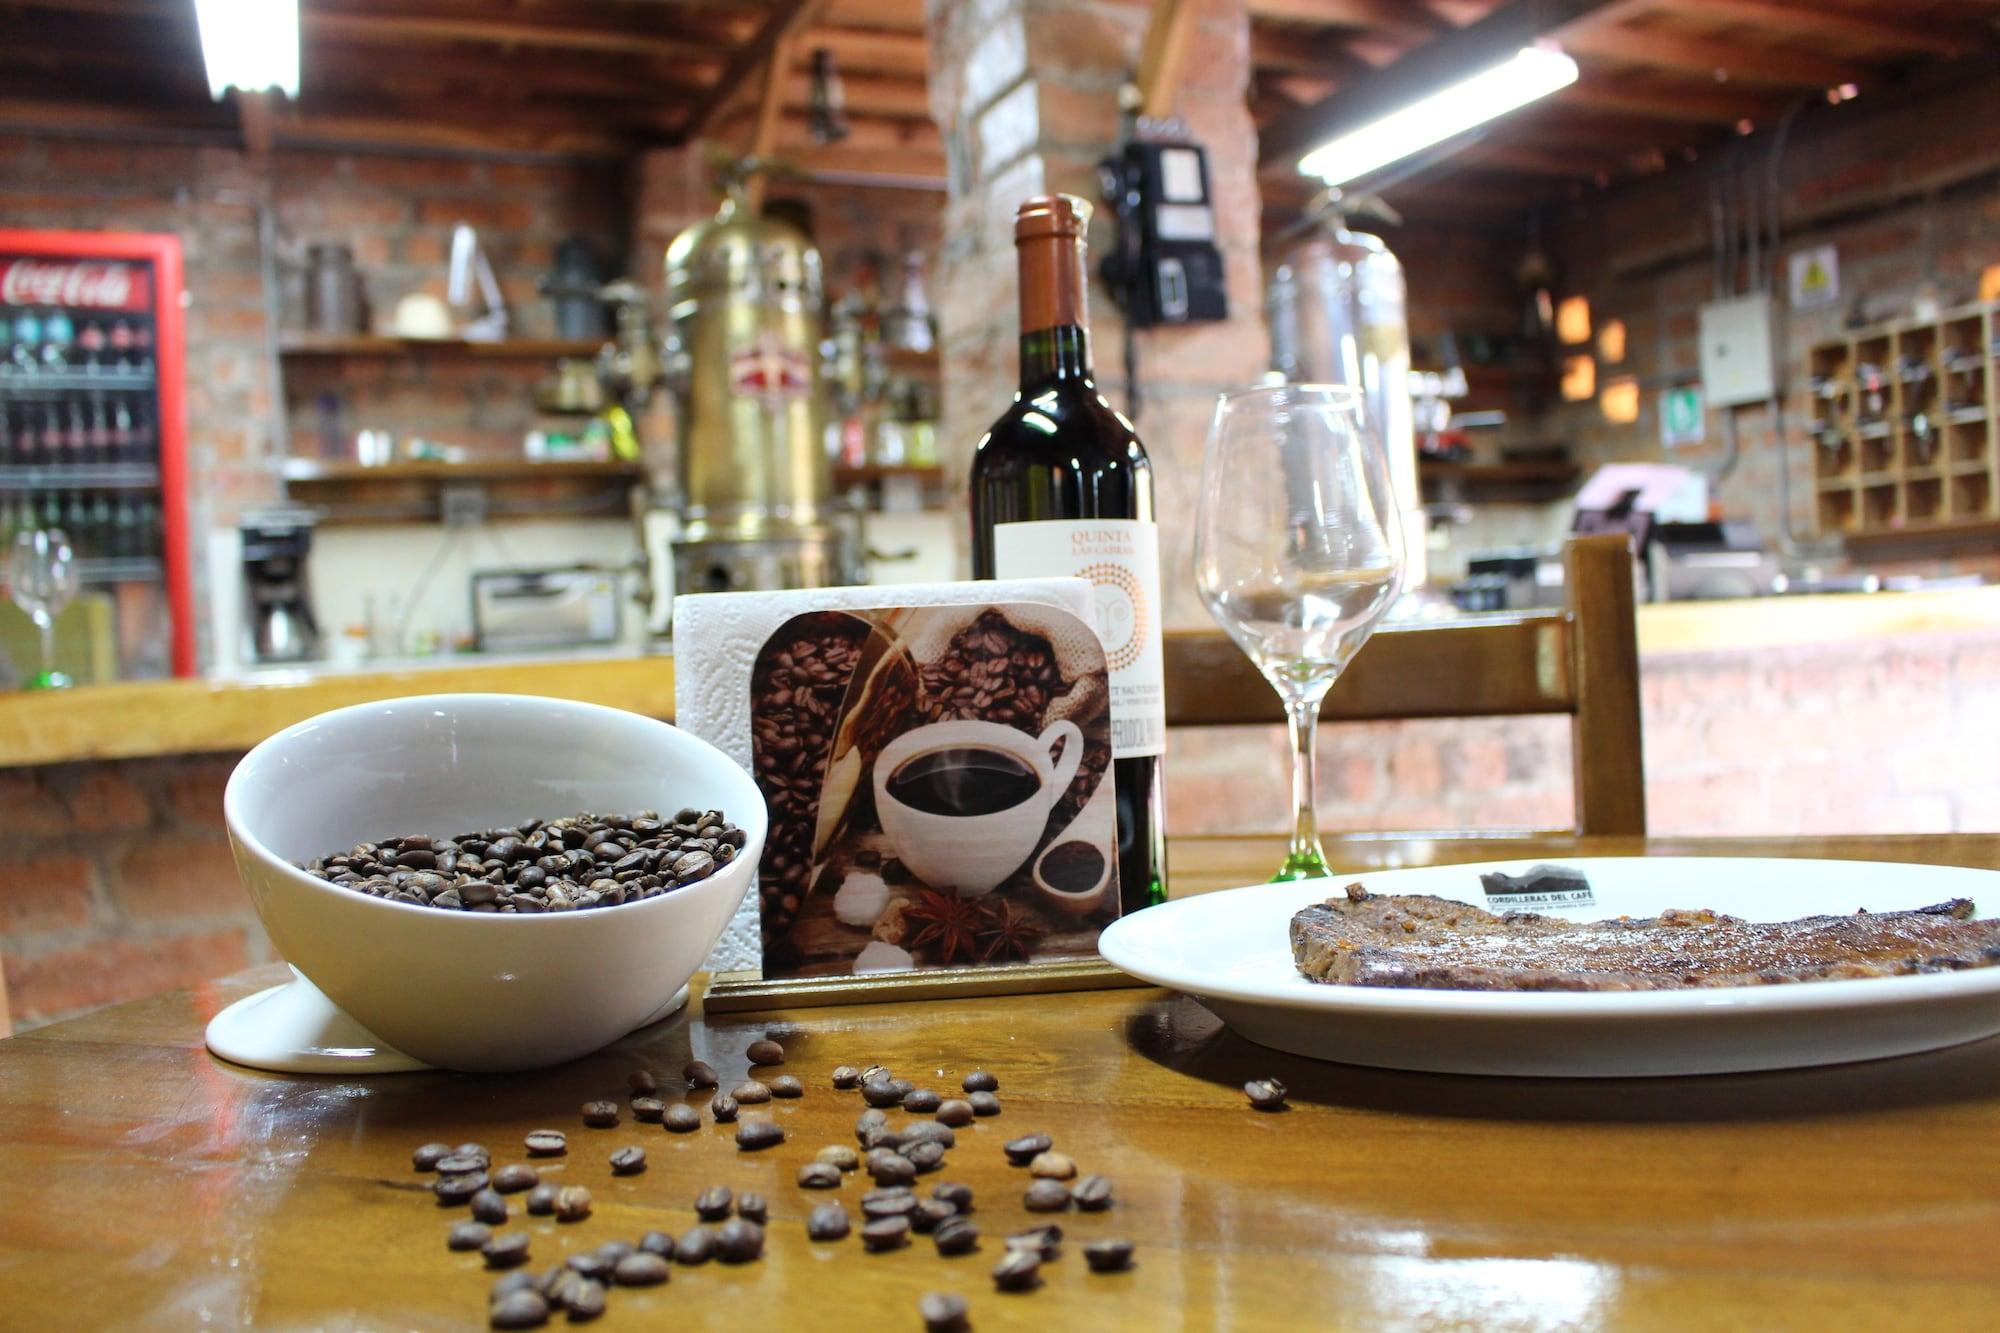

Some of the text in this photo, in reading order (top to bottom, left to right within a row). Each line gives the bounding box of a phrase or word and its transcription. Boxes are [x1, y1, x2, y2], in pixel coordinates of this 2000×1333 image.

[1072, 530, 1132, 545] QUINTA
[1487, 894, 1548, 904] CORDILLERAS
[1551, 893, 1568, 902] DEL
